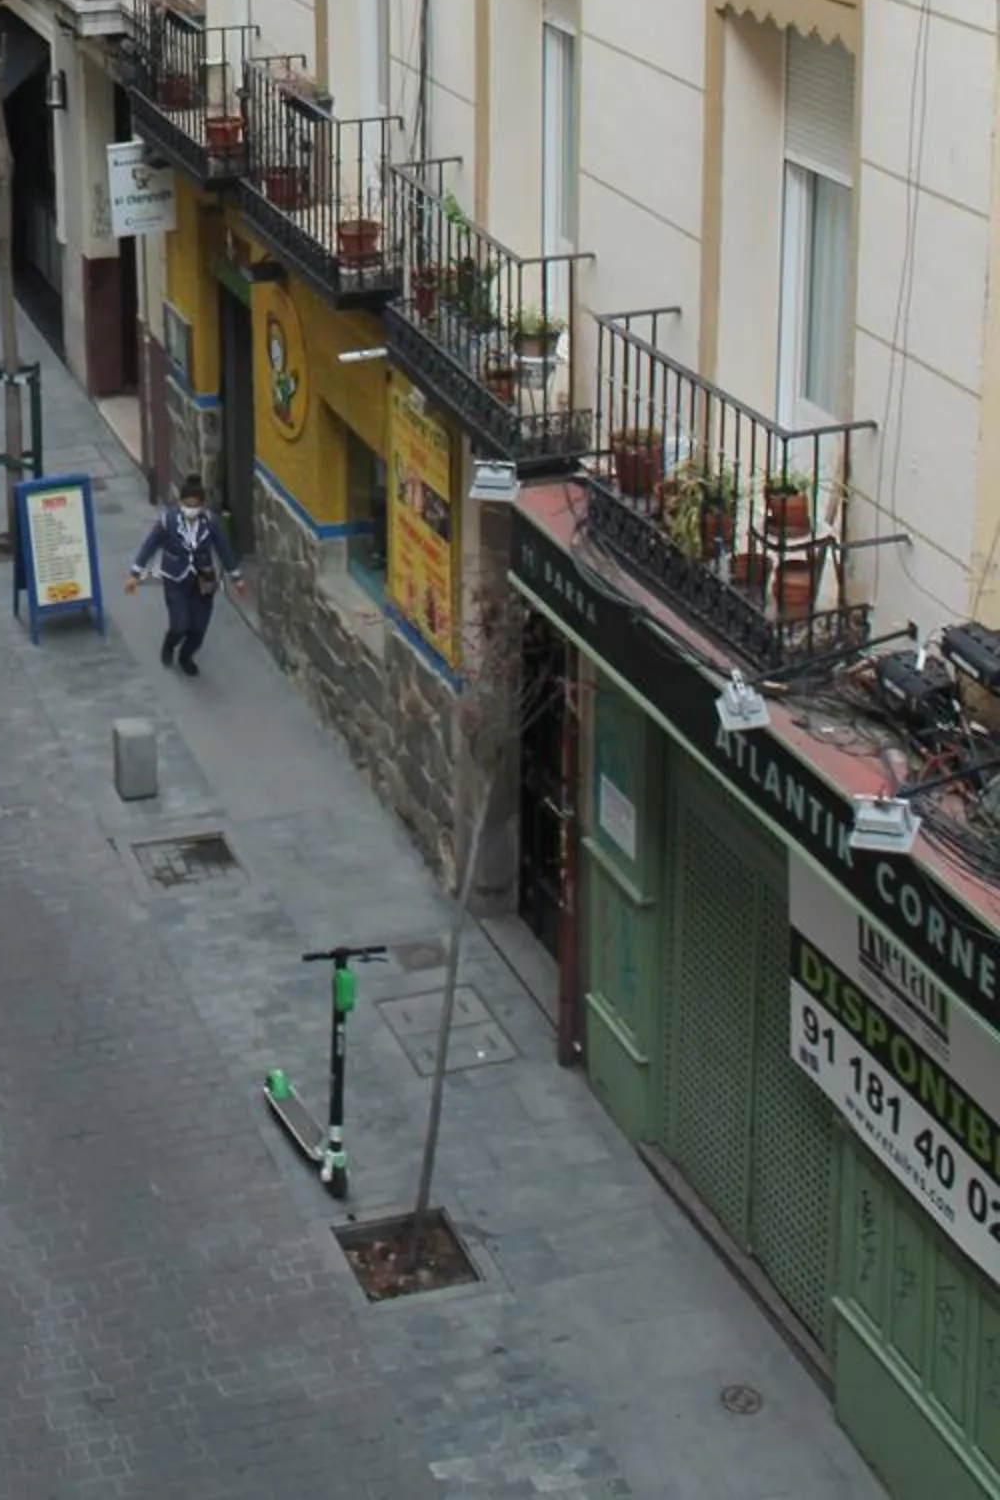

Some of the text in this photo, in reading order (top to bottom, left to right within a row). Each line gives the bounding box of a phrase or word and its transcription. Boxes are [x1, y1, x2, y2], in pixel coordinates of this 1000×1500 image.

[716, 724, 854, 868] ATLANTIK
[803, 1006, 835, 1065] 91
[850, 1056, 901, 1135] 181
[914, 1129, 956, 1189] 40
